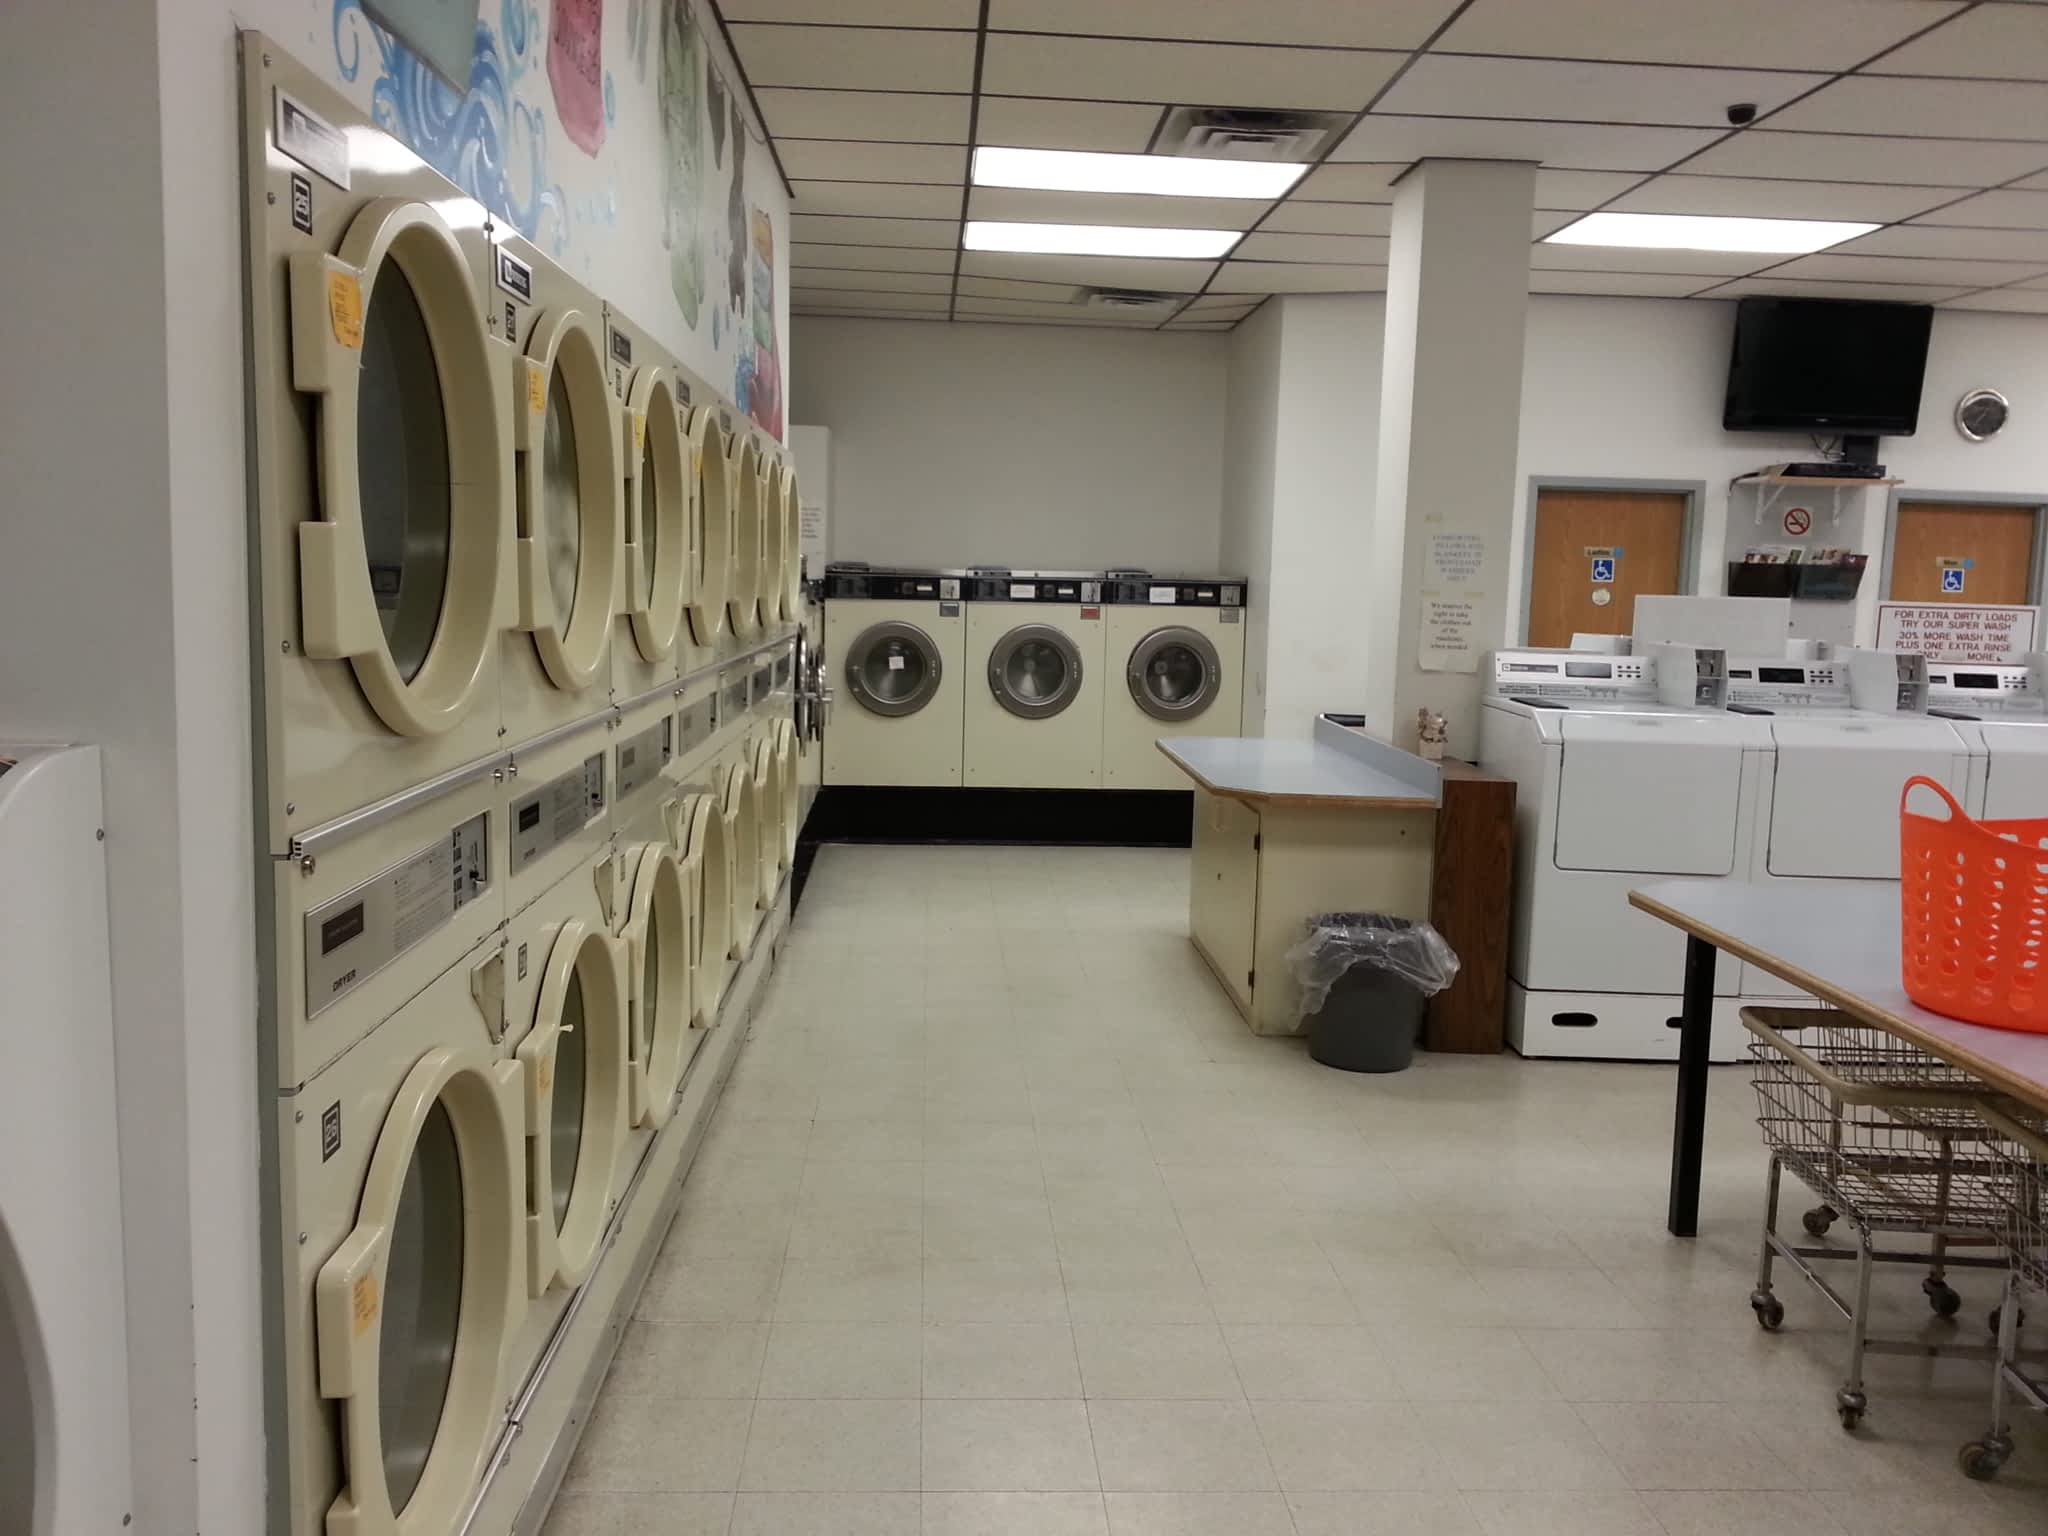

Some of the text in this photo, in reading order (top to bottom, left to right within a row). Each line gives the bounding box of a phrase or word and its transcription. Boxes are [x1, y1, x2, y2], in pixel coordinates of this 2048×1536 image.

[1894, 610, 2017, 622] FOR EXTRA DIRTY LOADS
[1901, 620, 2011, 631] TRY OUR SUPER WASH
[1899, 630, 2009, 642] 30% MORE WASH TIME
[1895, 640, 2011, 652] PLUS ONE EXTRA RINSE
[1967, 652, 1994, 662] MORE
[332, 968, 356, 992] DRYER
